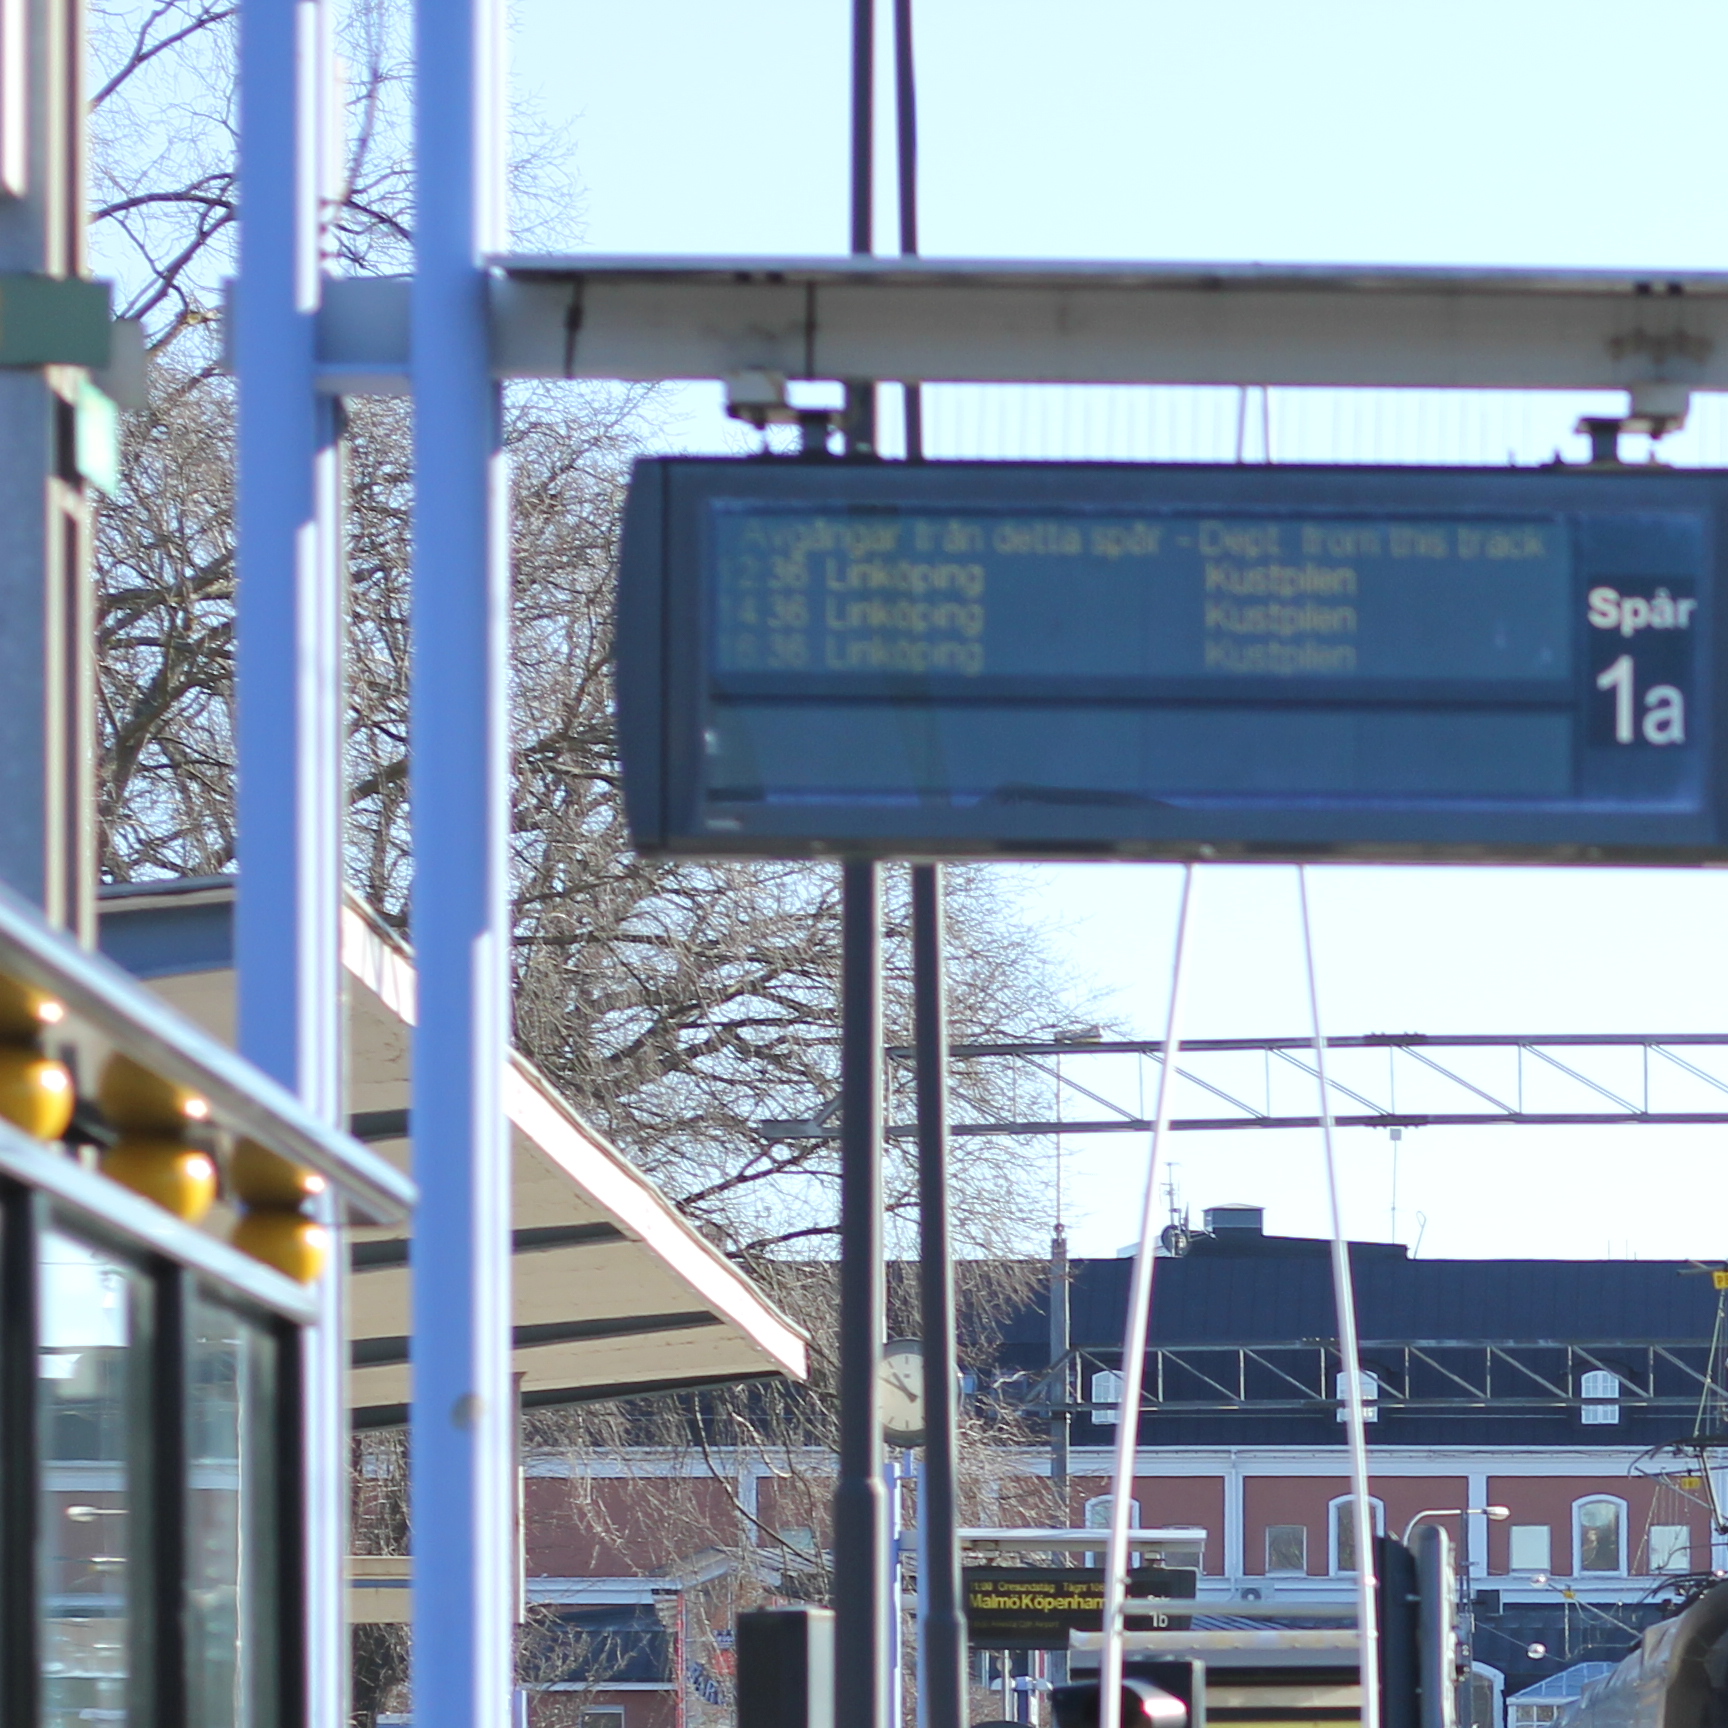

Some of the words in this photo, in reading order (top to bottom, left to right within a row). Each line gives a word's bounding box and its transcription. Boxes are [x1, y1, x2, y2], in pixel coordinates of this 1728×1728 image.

[1586, 585, 1697, 638] Spår
[1595, 654, 1686, 746] 1a
[969, 1593, 1020, 1609] Malmö
[1021, 1593, 1107, 1613] Köpenham
[1150, 1612, 1168, 1627] 1b
